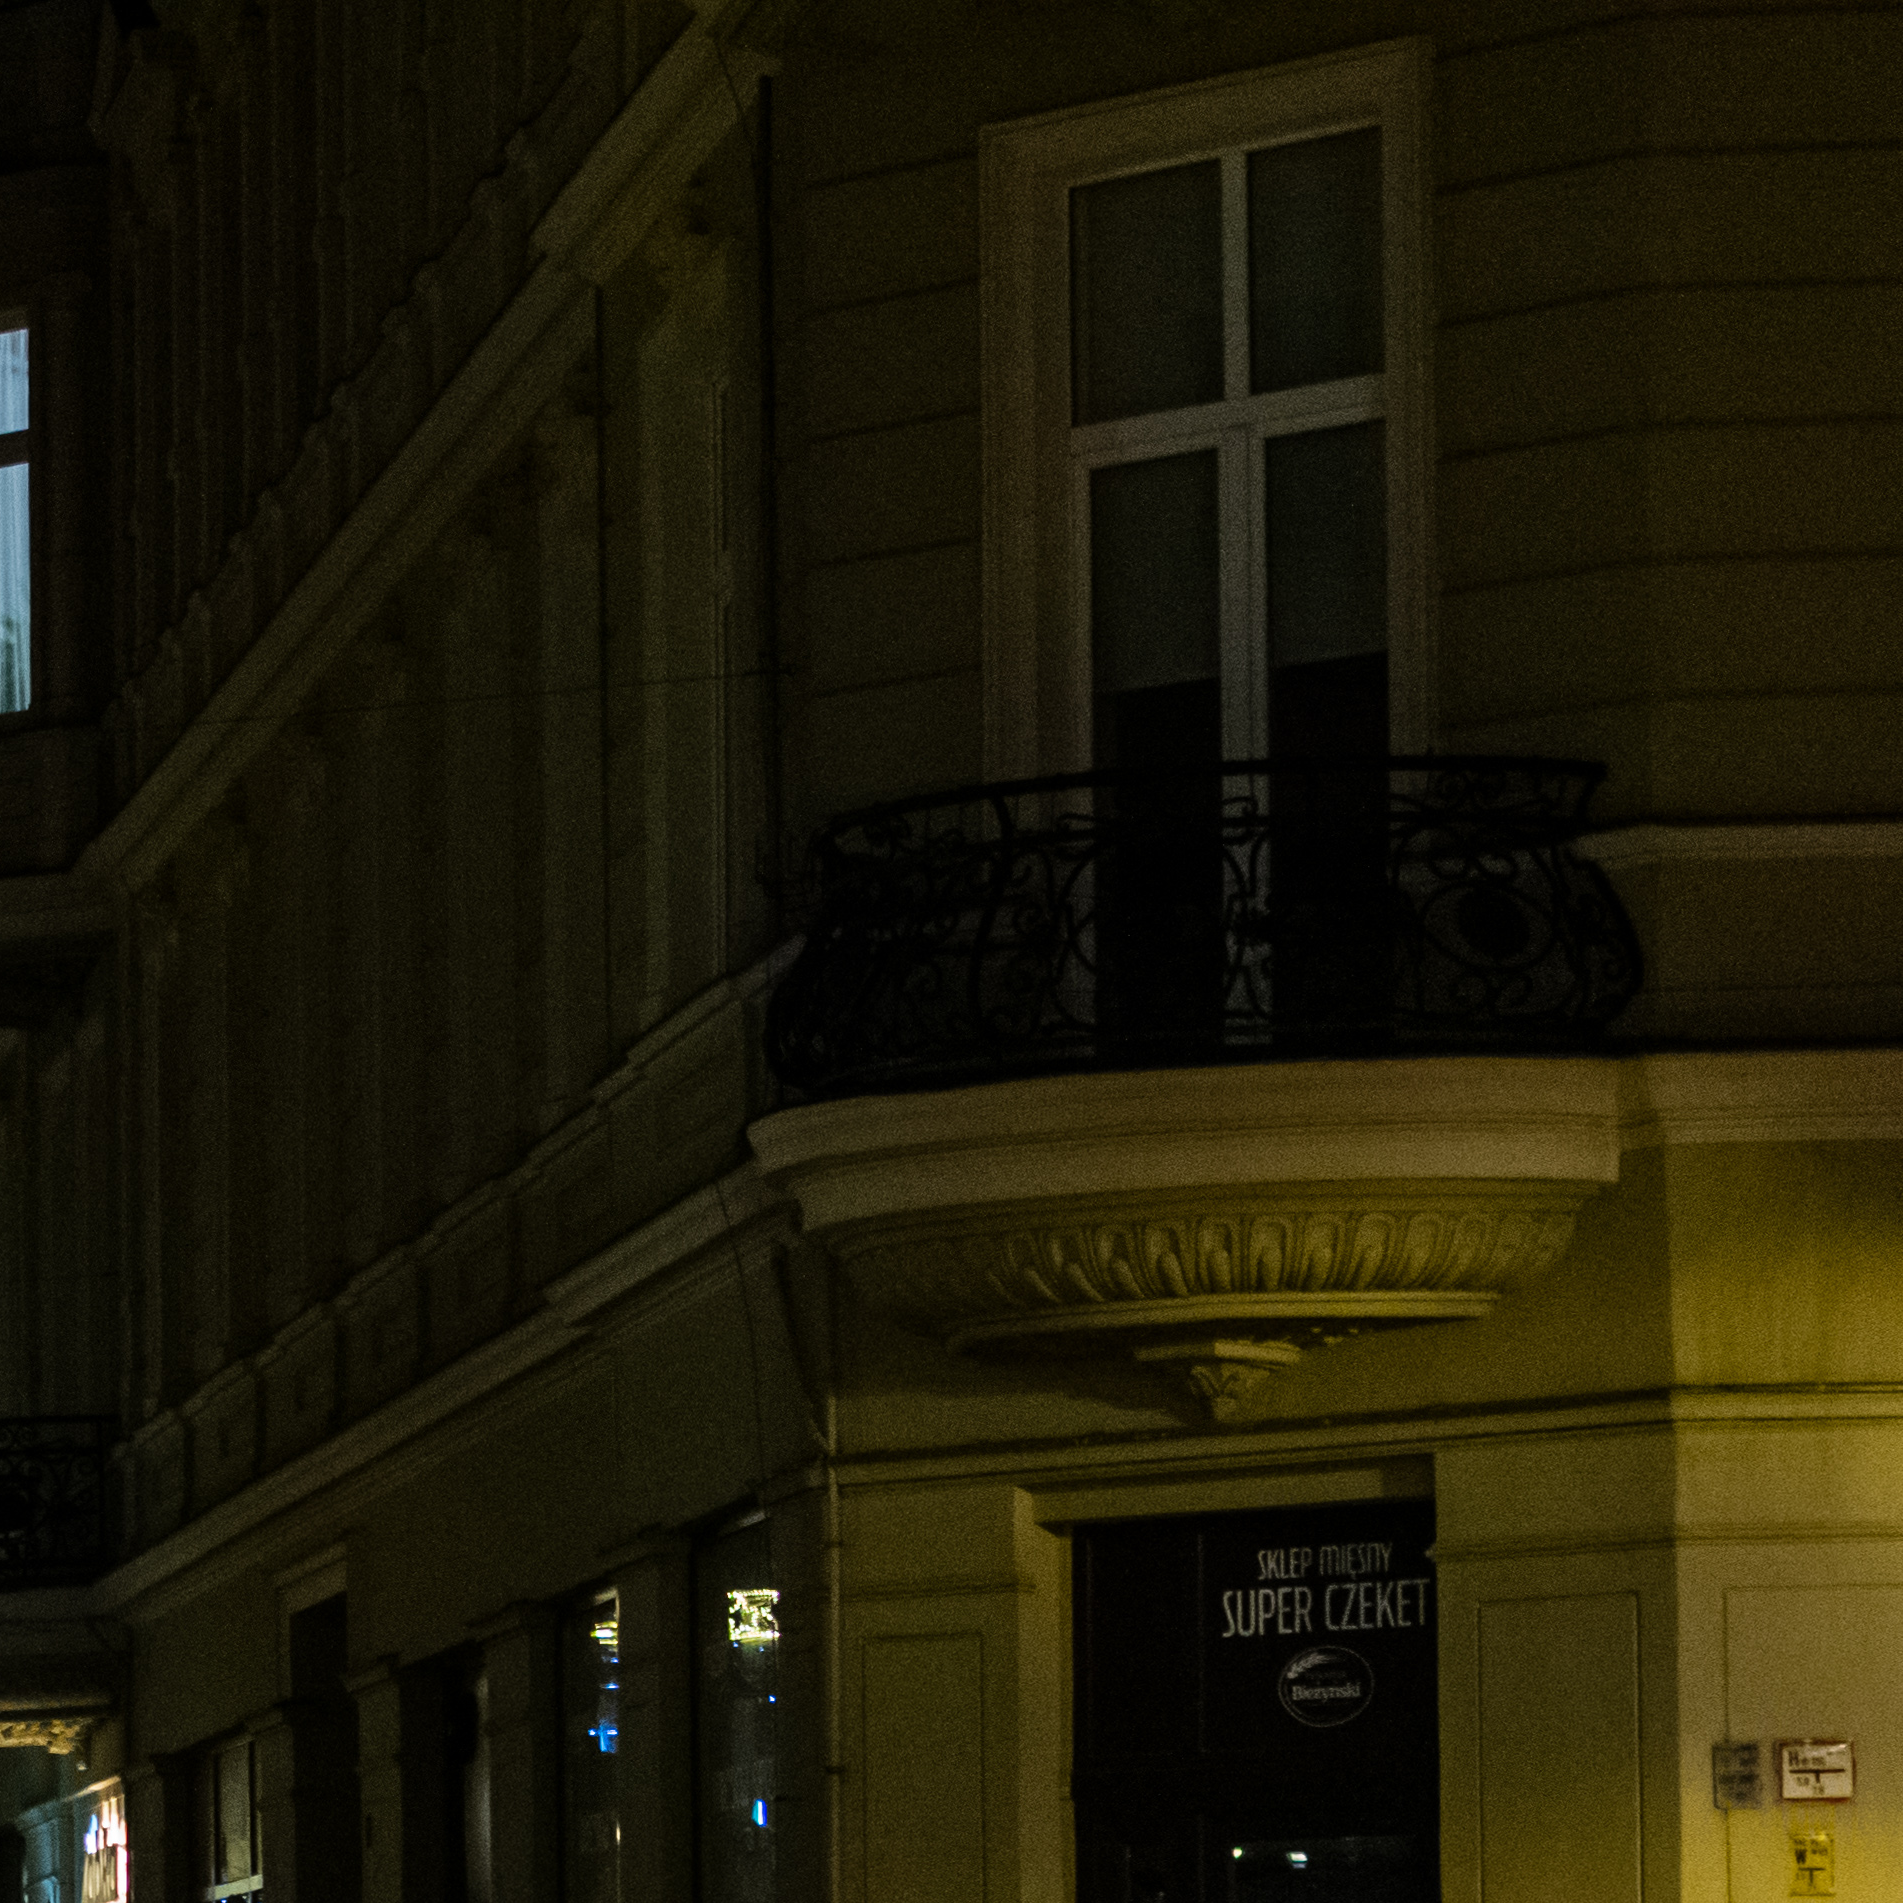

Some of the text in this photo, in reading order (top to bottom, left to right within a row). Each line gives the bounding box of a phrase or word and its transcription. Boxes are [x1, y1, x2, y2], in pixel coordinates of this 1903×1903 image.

[1257, 1548, 1313, 1580] SKLEP
[1222, 1578, 1430, 1638] SUPER CZEKET
